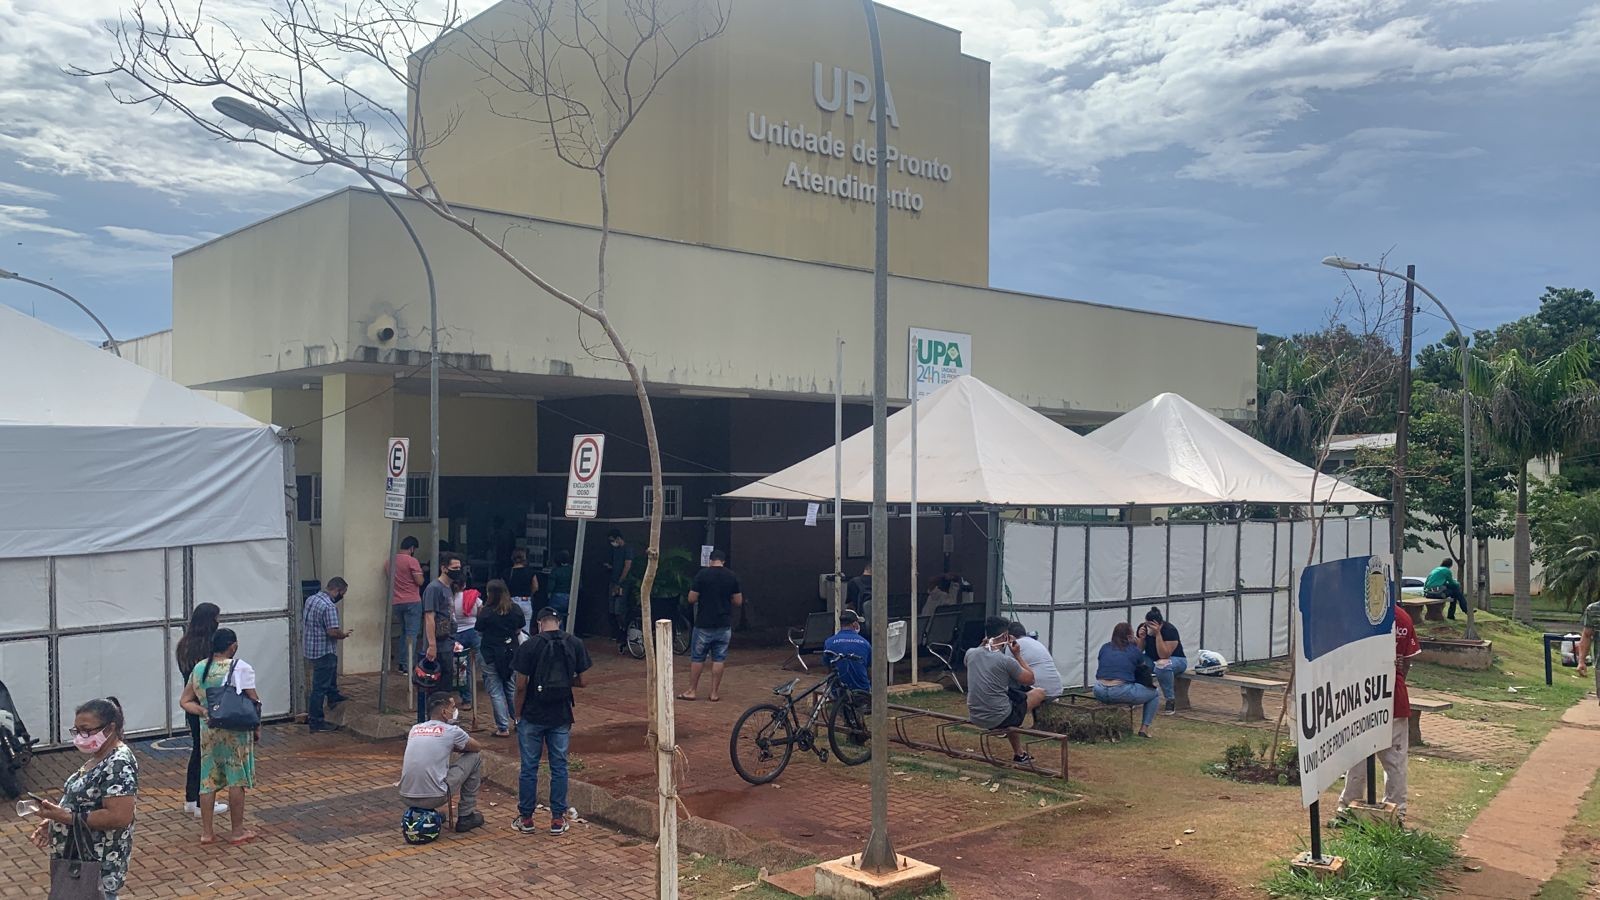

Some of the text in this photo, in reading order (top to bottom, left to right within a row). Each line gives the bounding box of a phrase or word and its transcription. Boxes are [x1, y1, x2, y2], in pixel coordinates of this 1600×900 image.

[813, 61, 899, 128] UPA
[749, 111, 952, 182] Unidade de Pronto
[783, 161, 924, 212] Atendimnto
[917, 338, 963, 369] UPA
[917, 365, 940, 385] 24h
[392, 447, 402, 470] E
[579, 447, 593, 473] E
[1301, 674, 1393, 740] UPA ZONA SUL
[1326, 738, 1333, 757] DE
[1332, 725, 1350, 753] PRONTO
[1351, 708, 1389, 741] ATENDIMENTO
